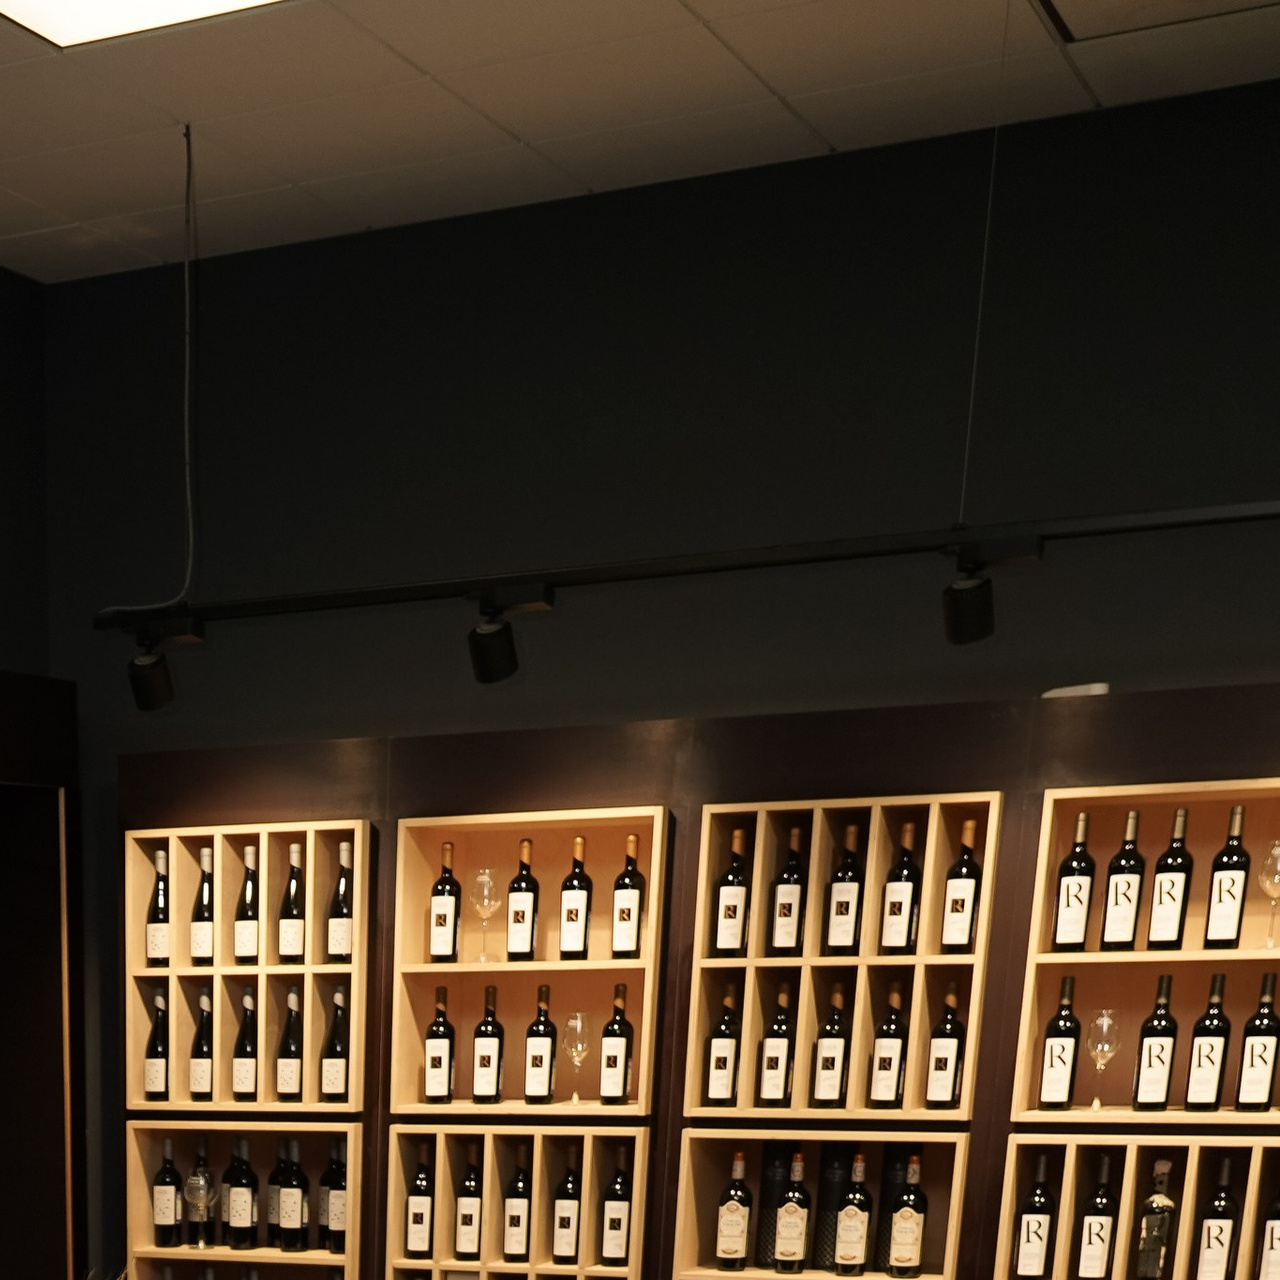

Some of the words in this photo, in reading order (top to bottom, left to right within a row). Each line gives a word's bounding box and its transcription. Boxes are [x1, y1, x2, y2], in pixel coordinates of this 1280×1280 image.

[1066, 883, 1083, 908] R
[1114, 881, 1131, 906] R
[1158, 880, 1176, 905] R
[1218, 878, 1236, 903] R
[1050, 1044, 1066, 1068] R
[1148, 1044, 1165, 1068] R
[1197, 1044, 1214, 1068] R
[1250, 1043, 1267, 1068] R
[1025, 1220, 1043, 1243] R
[1087, 1222, 1105, 1245] R
[1206, 1226, 1224, 1249] R
